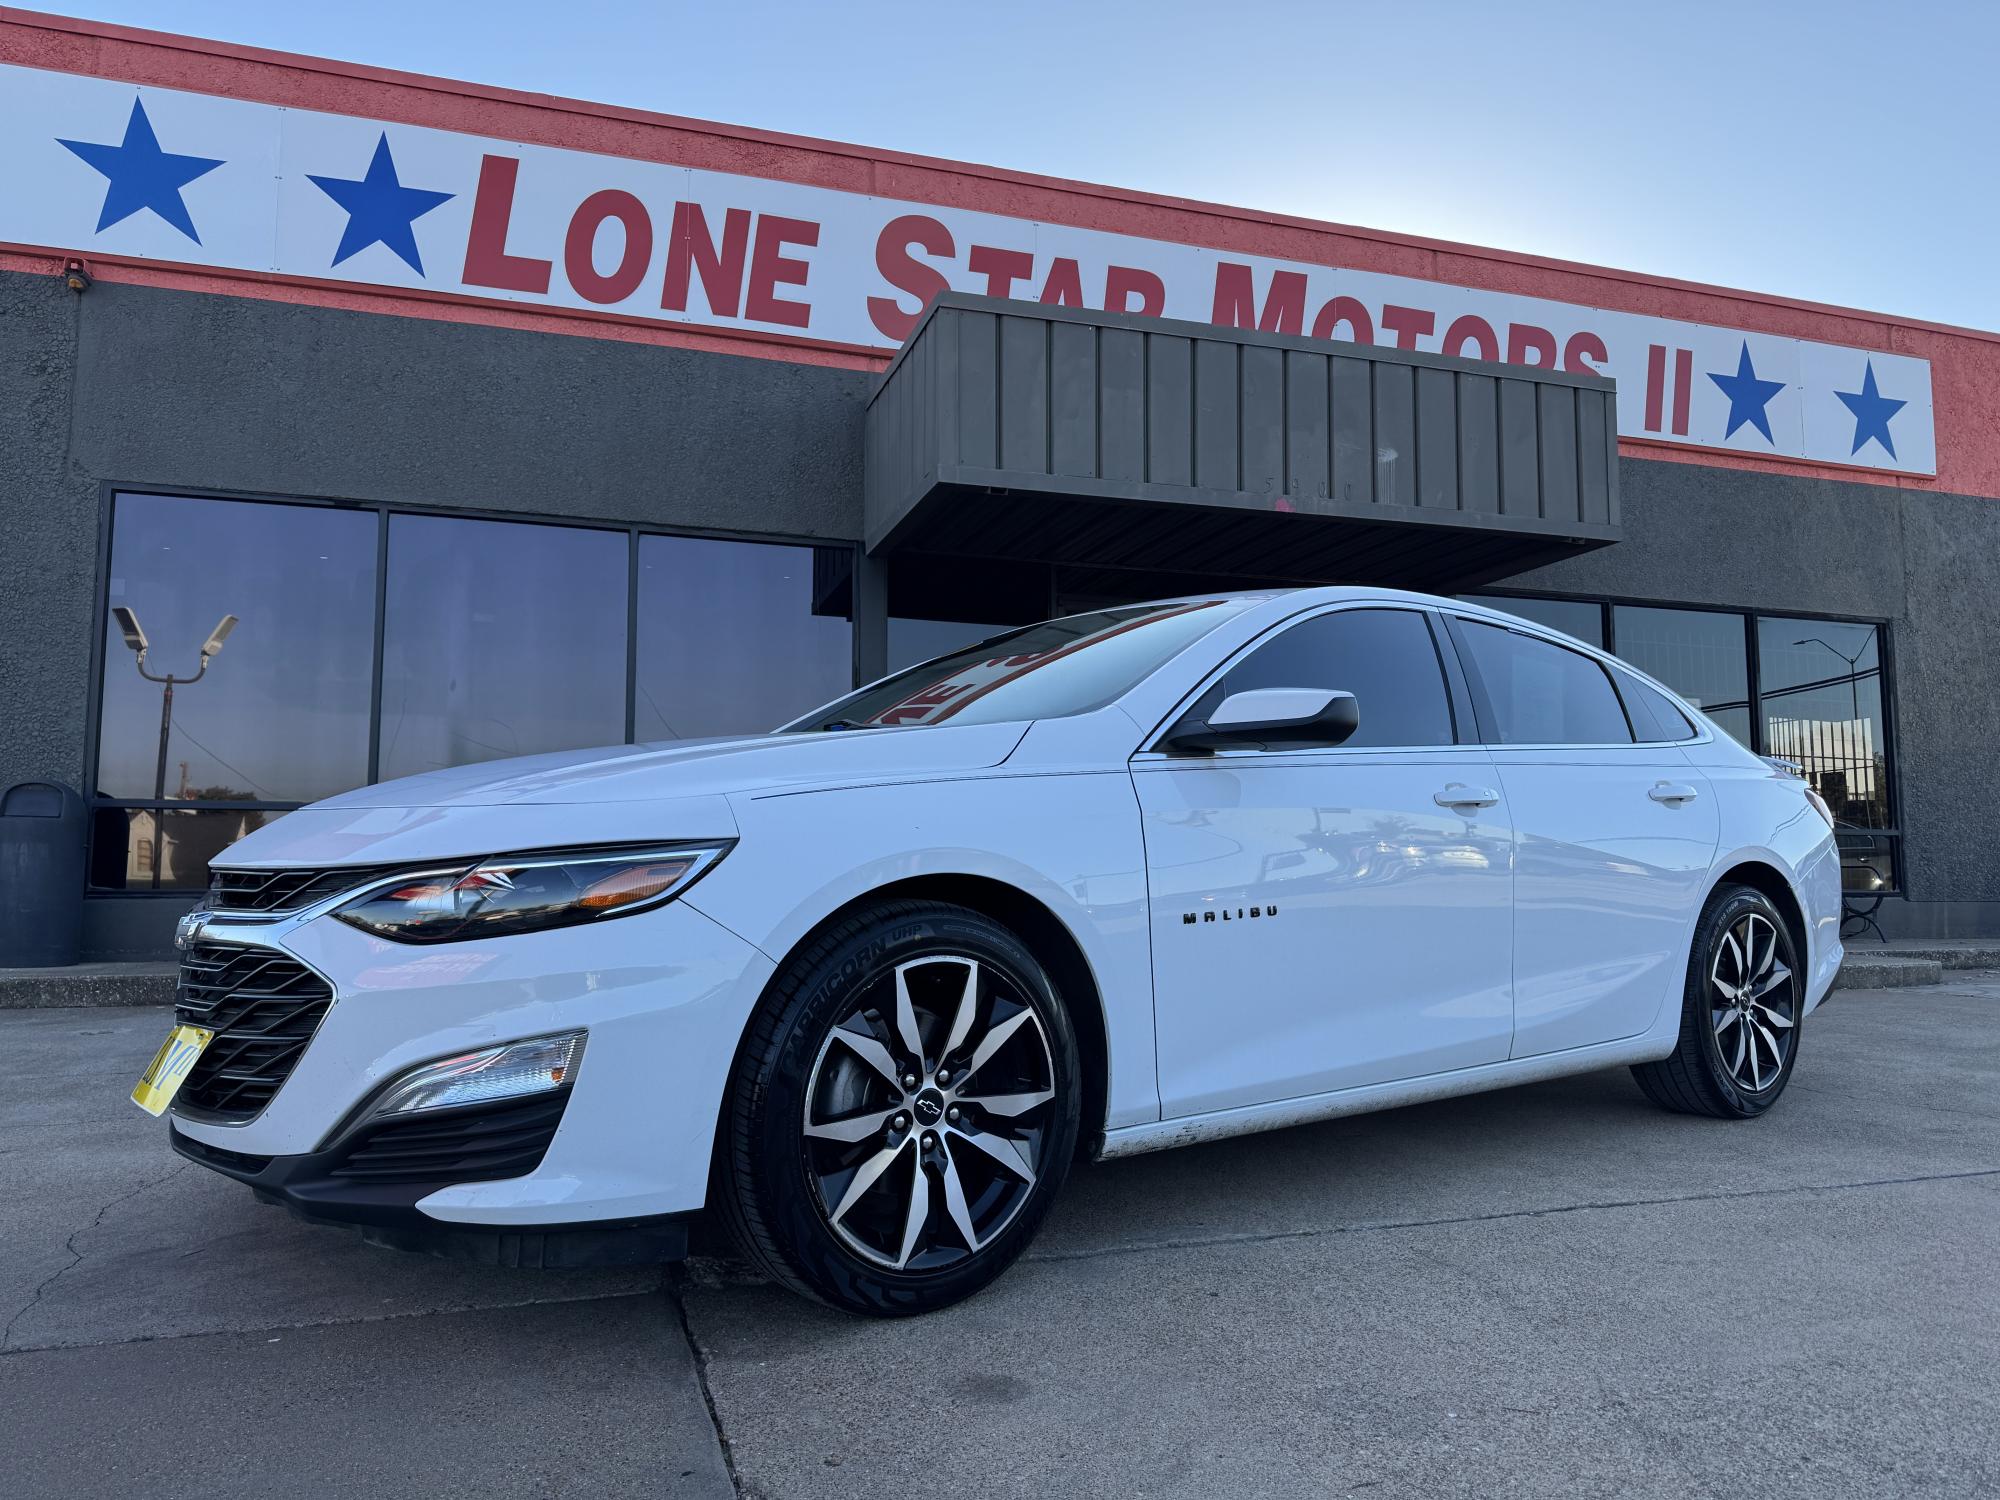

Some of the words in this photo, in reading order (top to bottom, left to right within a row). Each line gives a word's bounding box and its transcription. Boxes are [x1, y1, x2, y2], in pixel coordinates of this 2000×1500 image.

[461, 154, 821, 329] LONE
[1644, 343, 1693, 437] II
[1183, 905, 1278, 925] MALIBU
